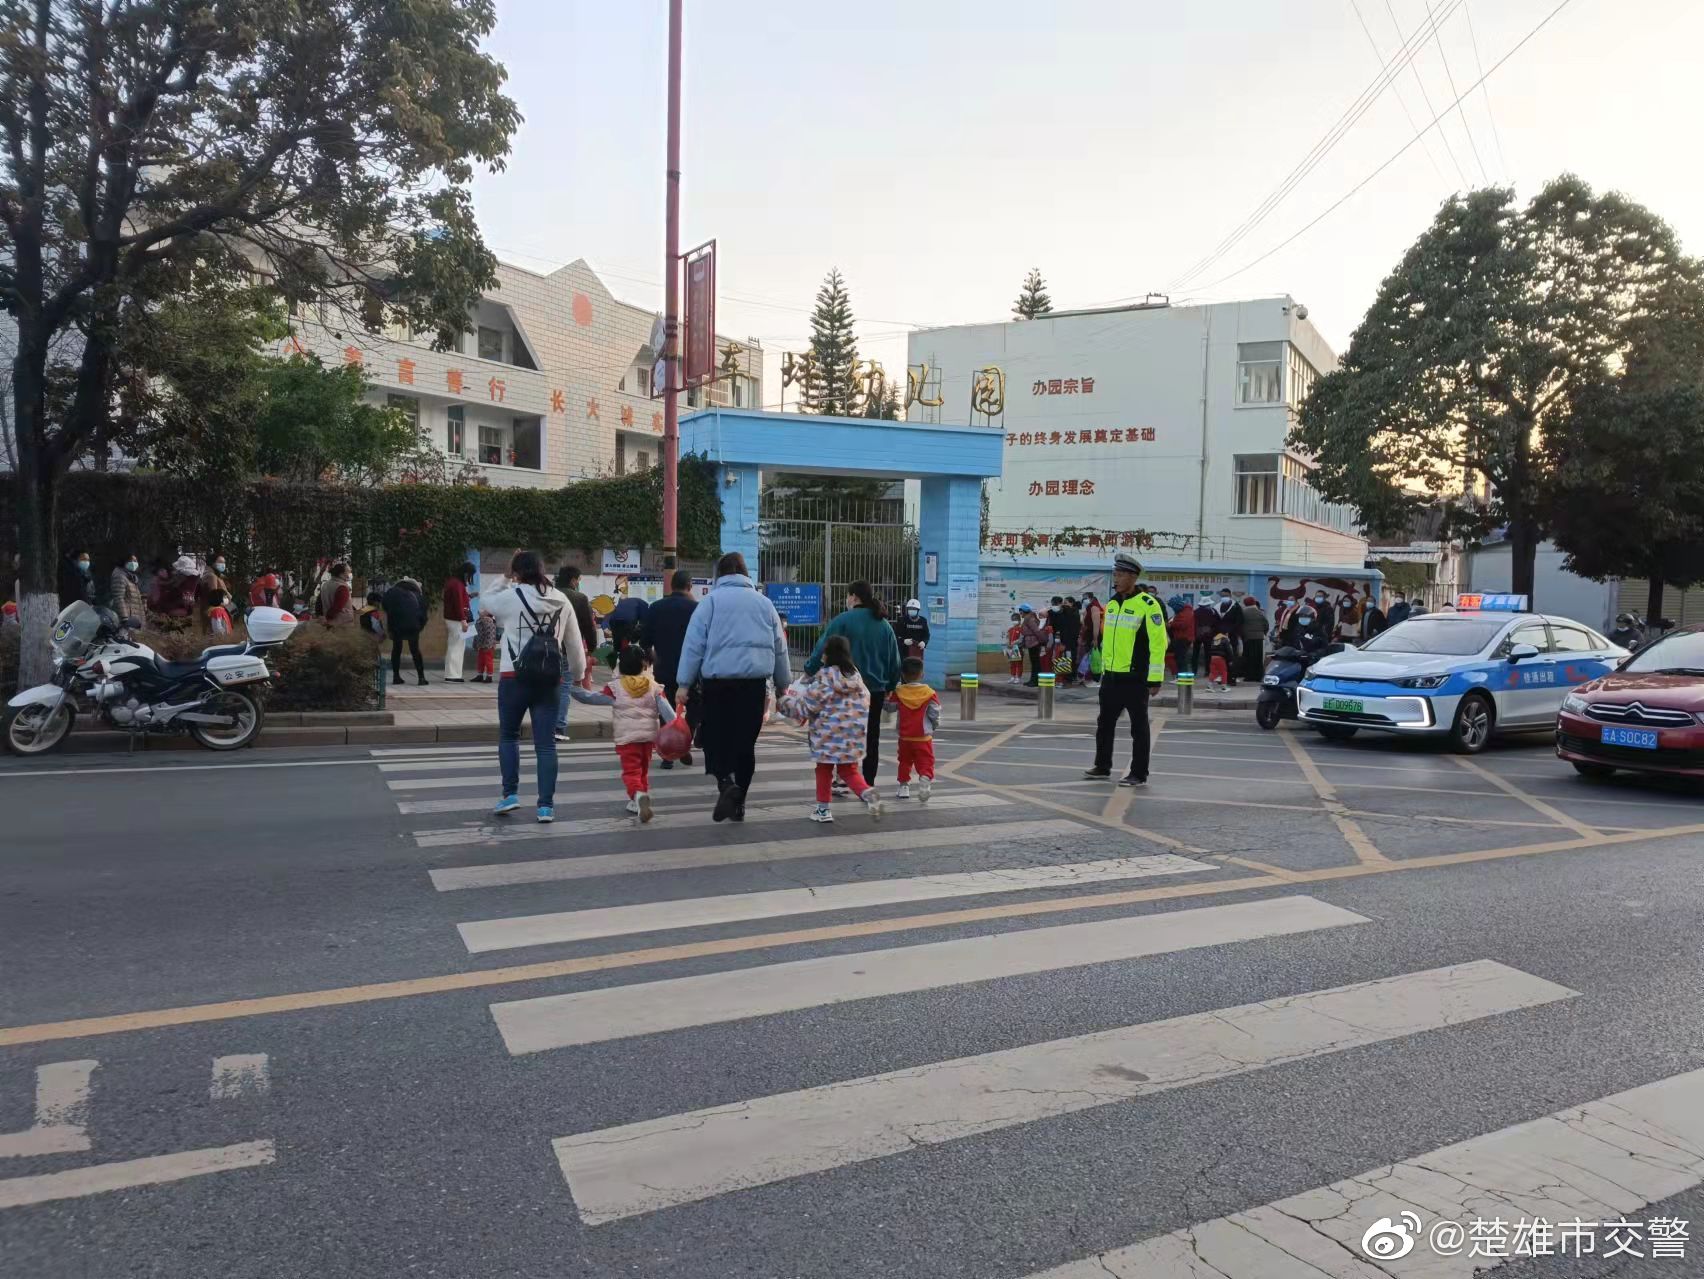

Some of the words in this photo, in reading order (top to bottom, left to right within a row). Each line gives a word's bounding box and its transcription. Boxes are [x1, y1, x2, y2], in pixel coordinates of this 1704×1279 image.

[1032, 376, 1095, 395] 办园宗旨
[1006, 426, 1156, 446] 子的终身发展奠定基础
[1028, 479, 1095, 496] 办园理念
[224, 671, 244, 680] 公安
